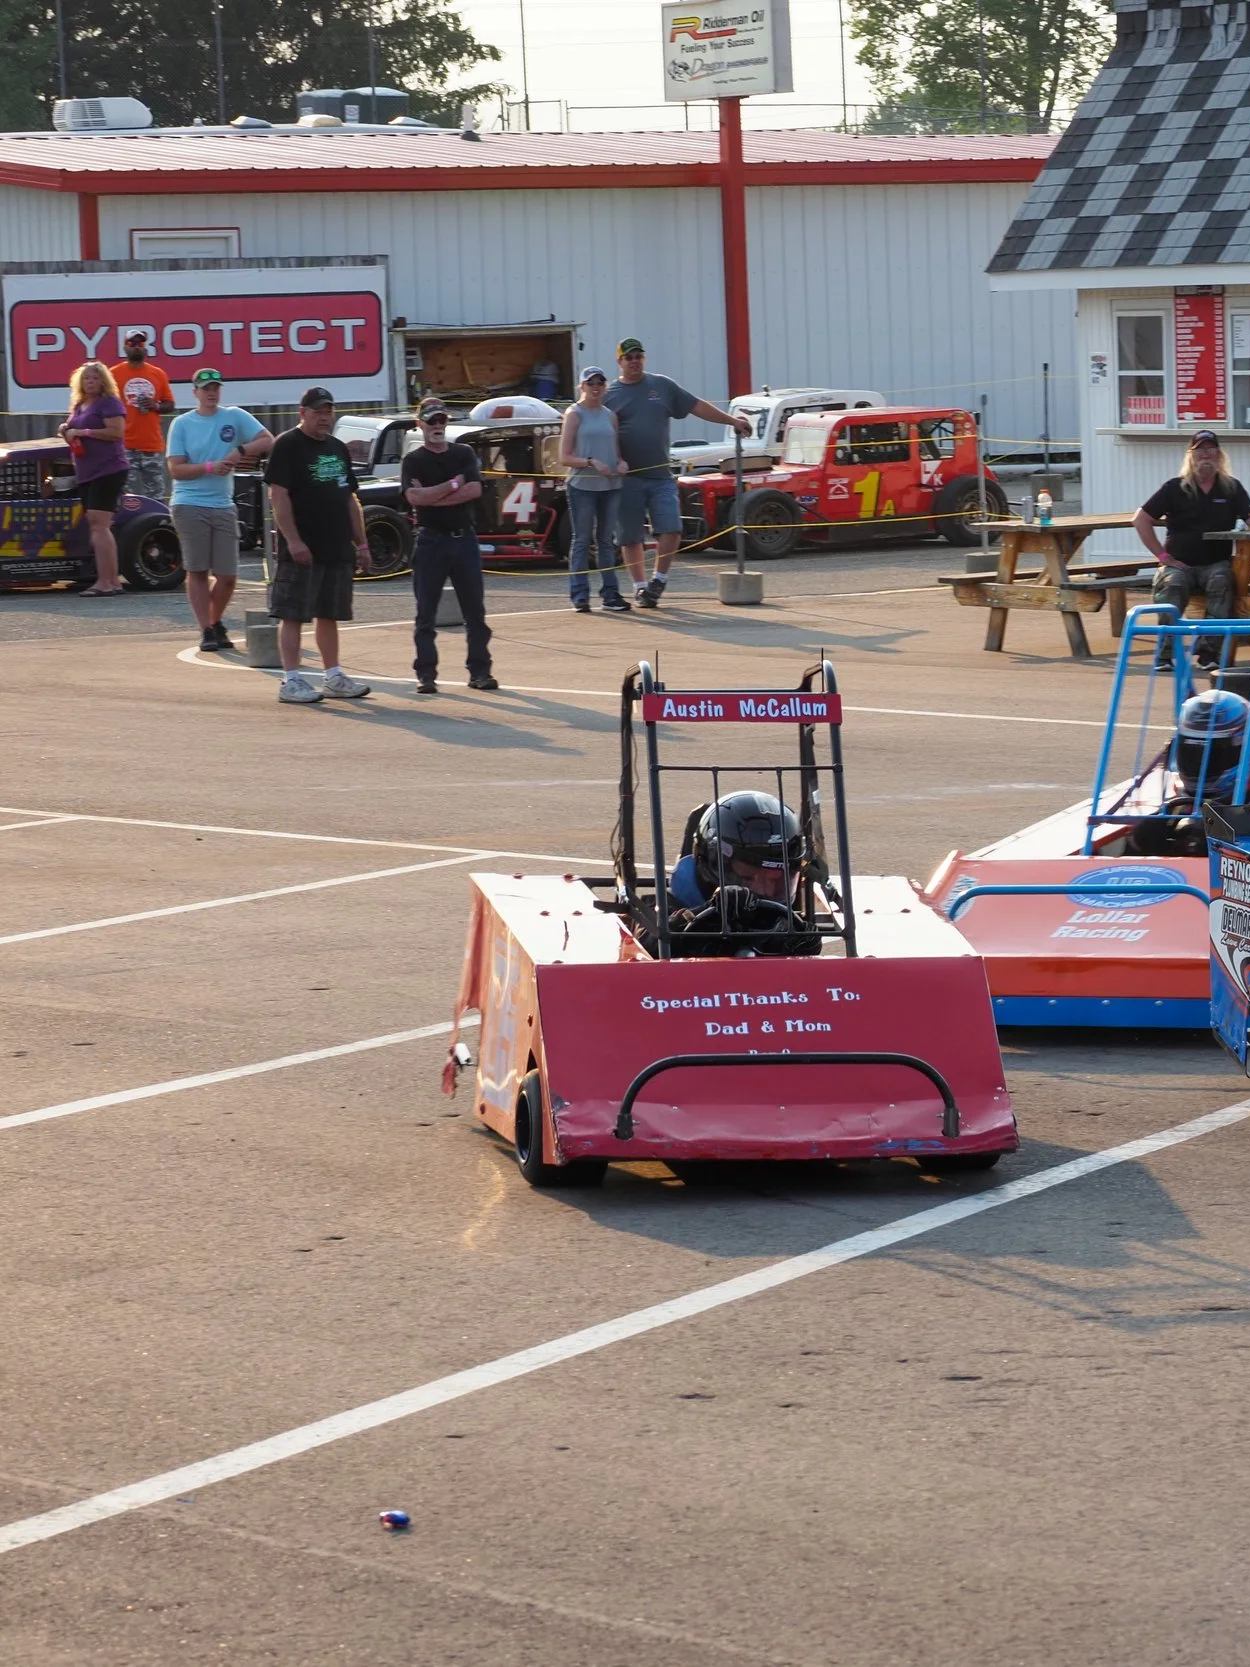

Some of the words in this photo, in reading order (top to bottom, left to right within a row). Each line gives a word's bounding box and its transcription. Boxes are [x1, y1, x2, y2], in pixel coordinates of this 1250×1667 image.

[680, 43, 707, 54] Fueling
[709, 41, 725, 50] Your
[727, 37, 755, 48] Success
[501, 480, 538, 524] 4
[662, 698, 724, 717] Austin
[739, 697, 827, 718] McCallum
[1066, 910, 1151, 923] Lollar
[1050, 925, 1152, 942] Racing
[640, 994, 721, 1013] Special
[724, 991, 809, 1007] Thanks
[826, 987, 861, 1002] To:
[704, 1021, 750, 1036] Dad
[761, 1020, 775, 1033] &
[784, 1019, 832, 1033] Mom
